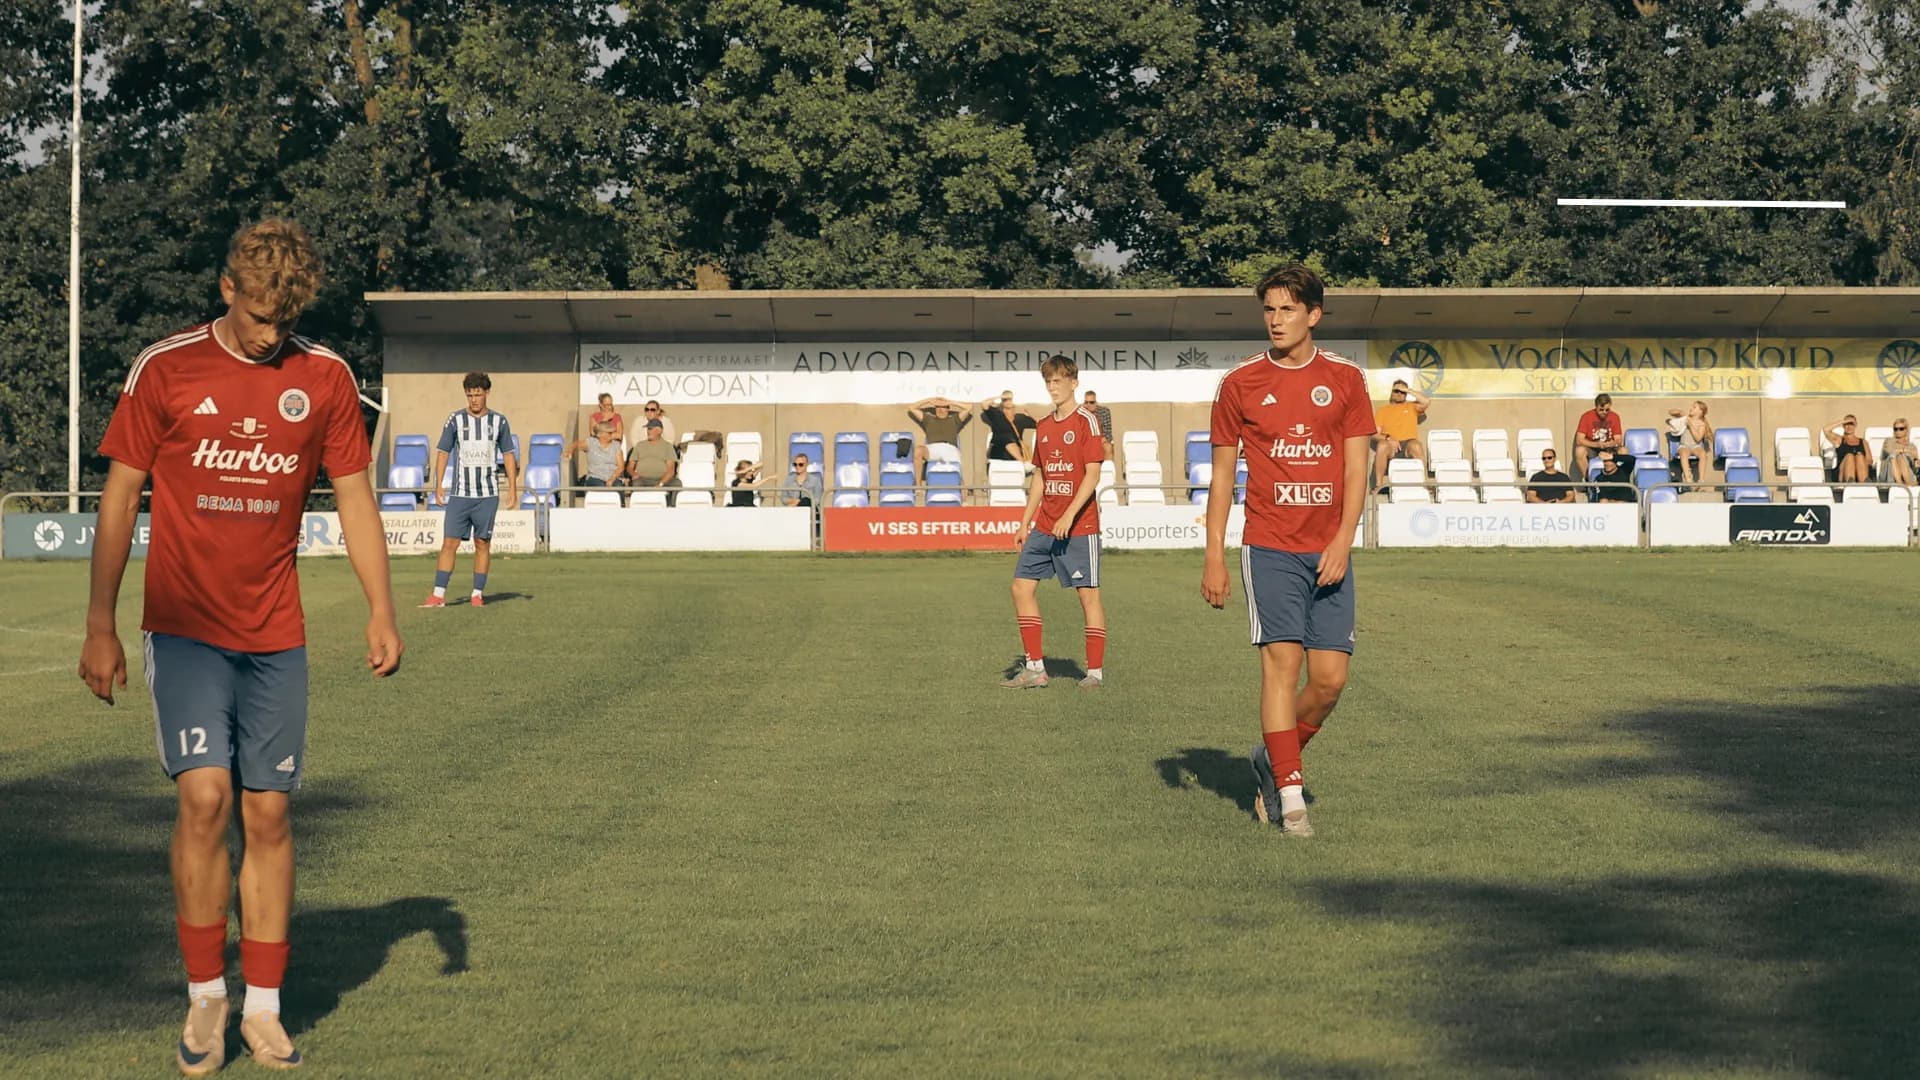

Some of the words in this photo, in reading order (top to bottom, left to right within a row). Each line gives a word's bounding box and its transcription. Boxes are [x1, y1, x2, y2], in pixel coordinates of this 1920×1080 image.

[632, 354, 770, 367] ADVOKATFIRMAET
[1488, 343, 1718, 372] VOGNMAND
[1734, 342, 1834, 370] KOLD
[624, 373, 770, 398] ADVODAN
[1632, 375, 1700, 392] BYENS
[191, 438, 300, 475] Harboe
[1269, 438, 1333, 458] Harboe
[196, 494, 244, 512] REMA
[246, 498, 281, 514] 1000
[868, 522, 884, 535] VI
[888, 522, 918, 535] SES
[922, 521, 971, 535] EFTER
[1445, 516, 1513, 531] FORZA
[1519, 516, 1606, 531] LEASING
[413, 531, 435, 545] AS
[1105, 524, 1199, 542] supporters
[1736, 529, 1820, 542] AIRTOX
[178, 726, 209, 757] 12
